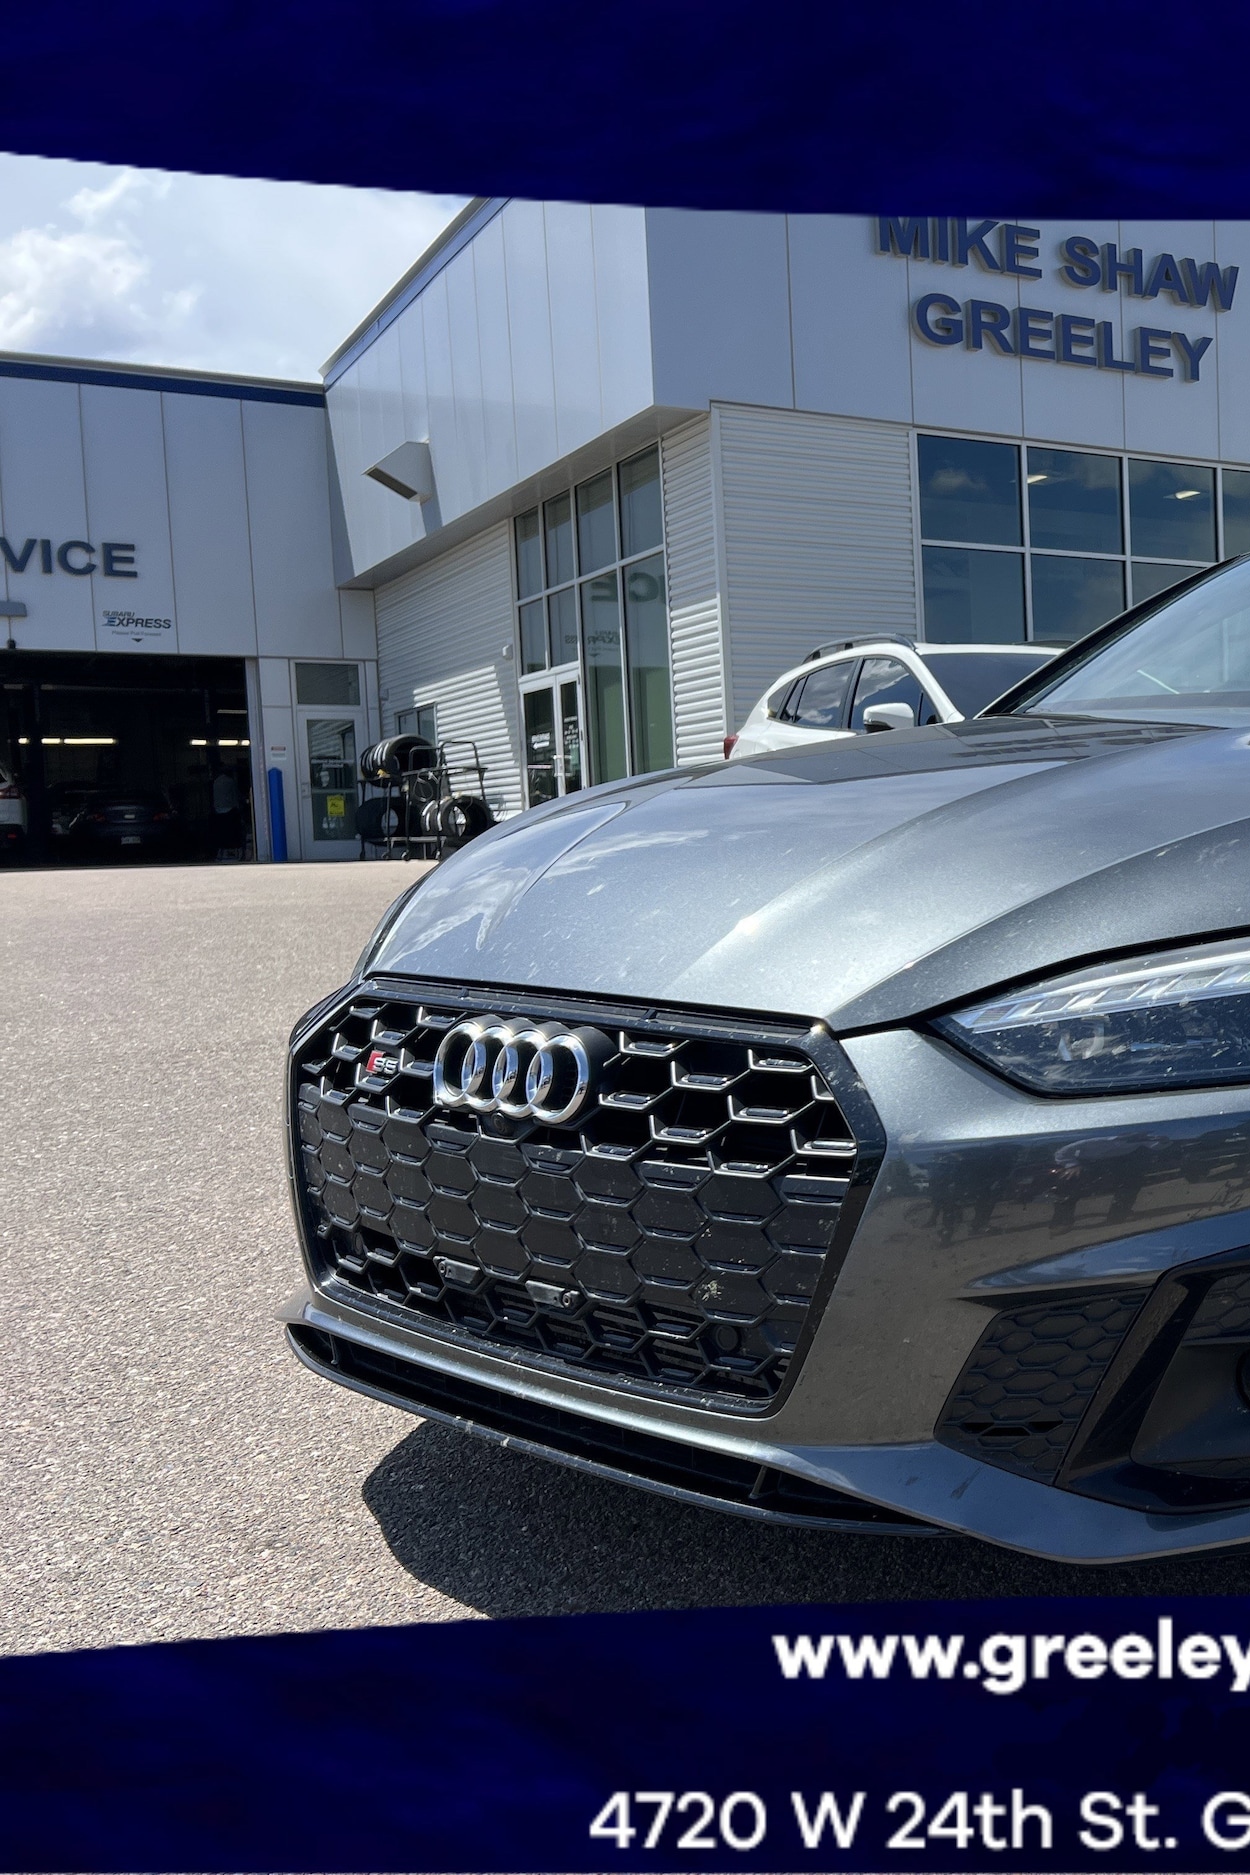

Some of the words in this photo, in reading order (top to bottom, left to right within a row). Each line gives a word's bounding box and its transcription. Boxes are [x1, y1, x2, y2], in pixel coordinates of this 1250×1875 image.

[874, 216, 1042, 279] MIKE
[1058, 236, 1240, 312] SHAW
[912, 293, 1214, 383] GREELEY
[0, 537, 138, 578] VICE
[103, 616, 172, 629] EXPRESS
